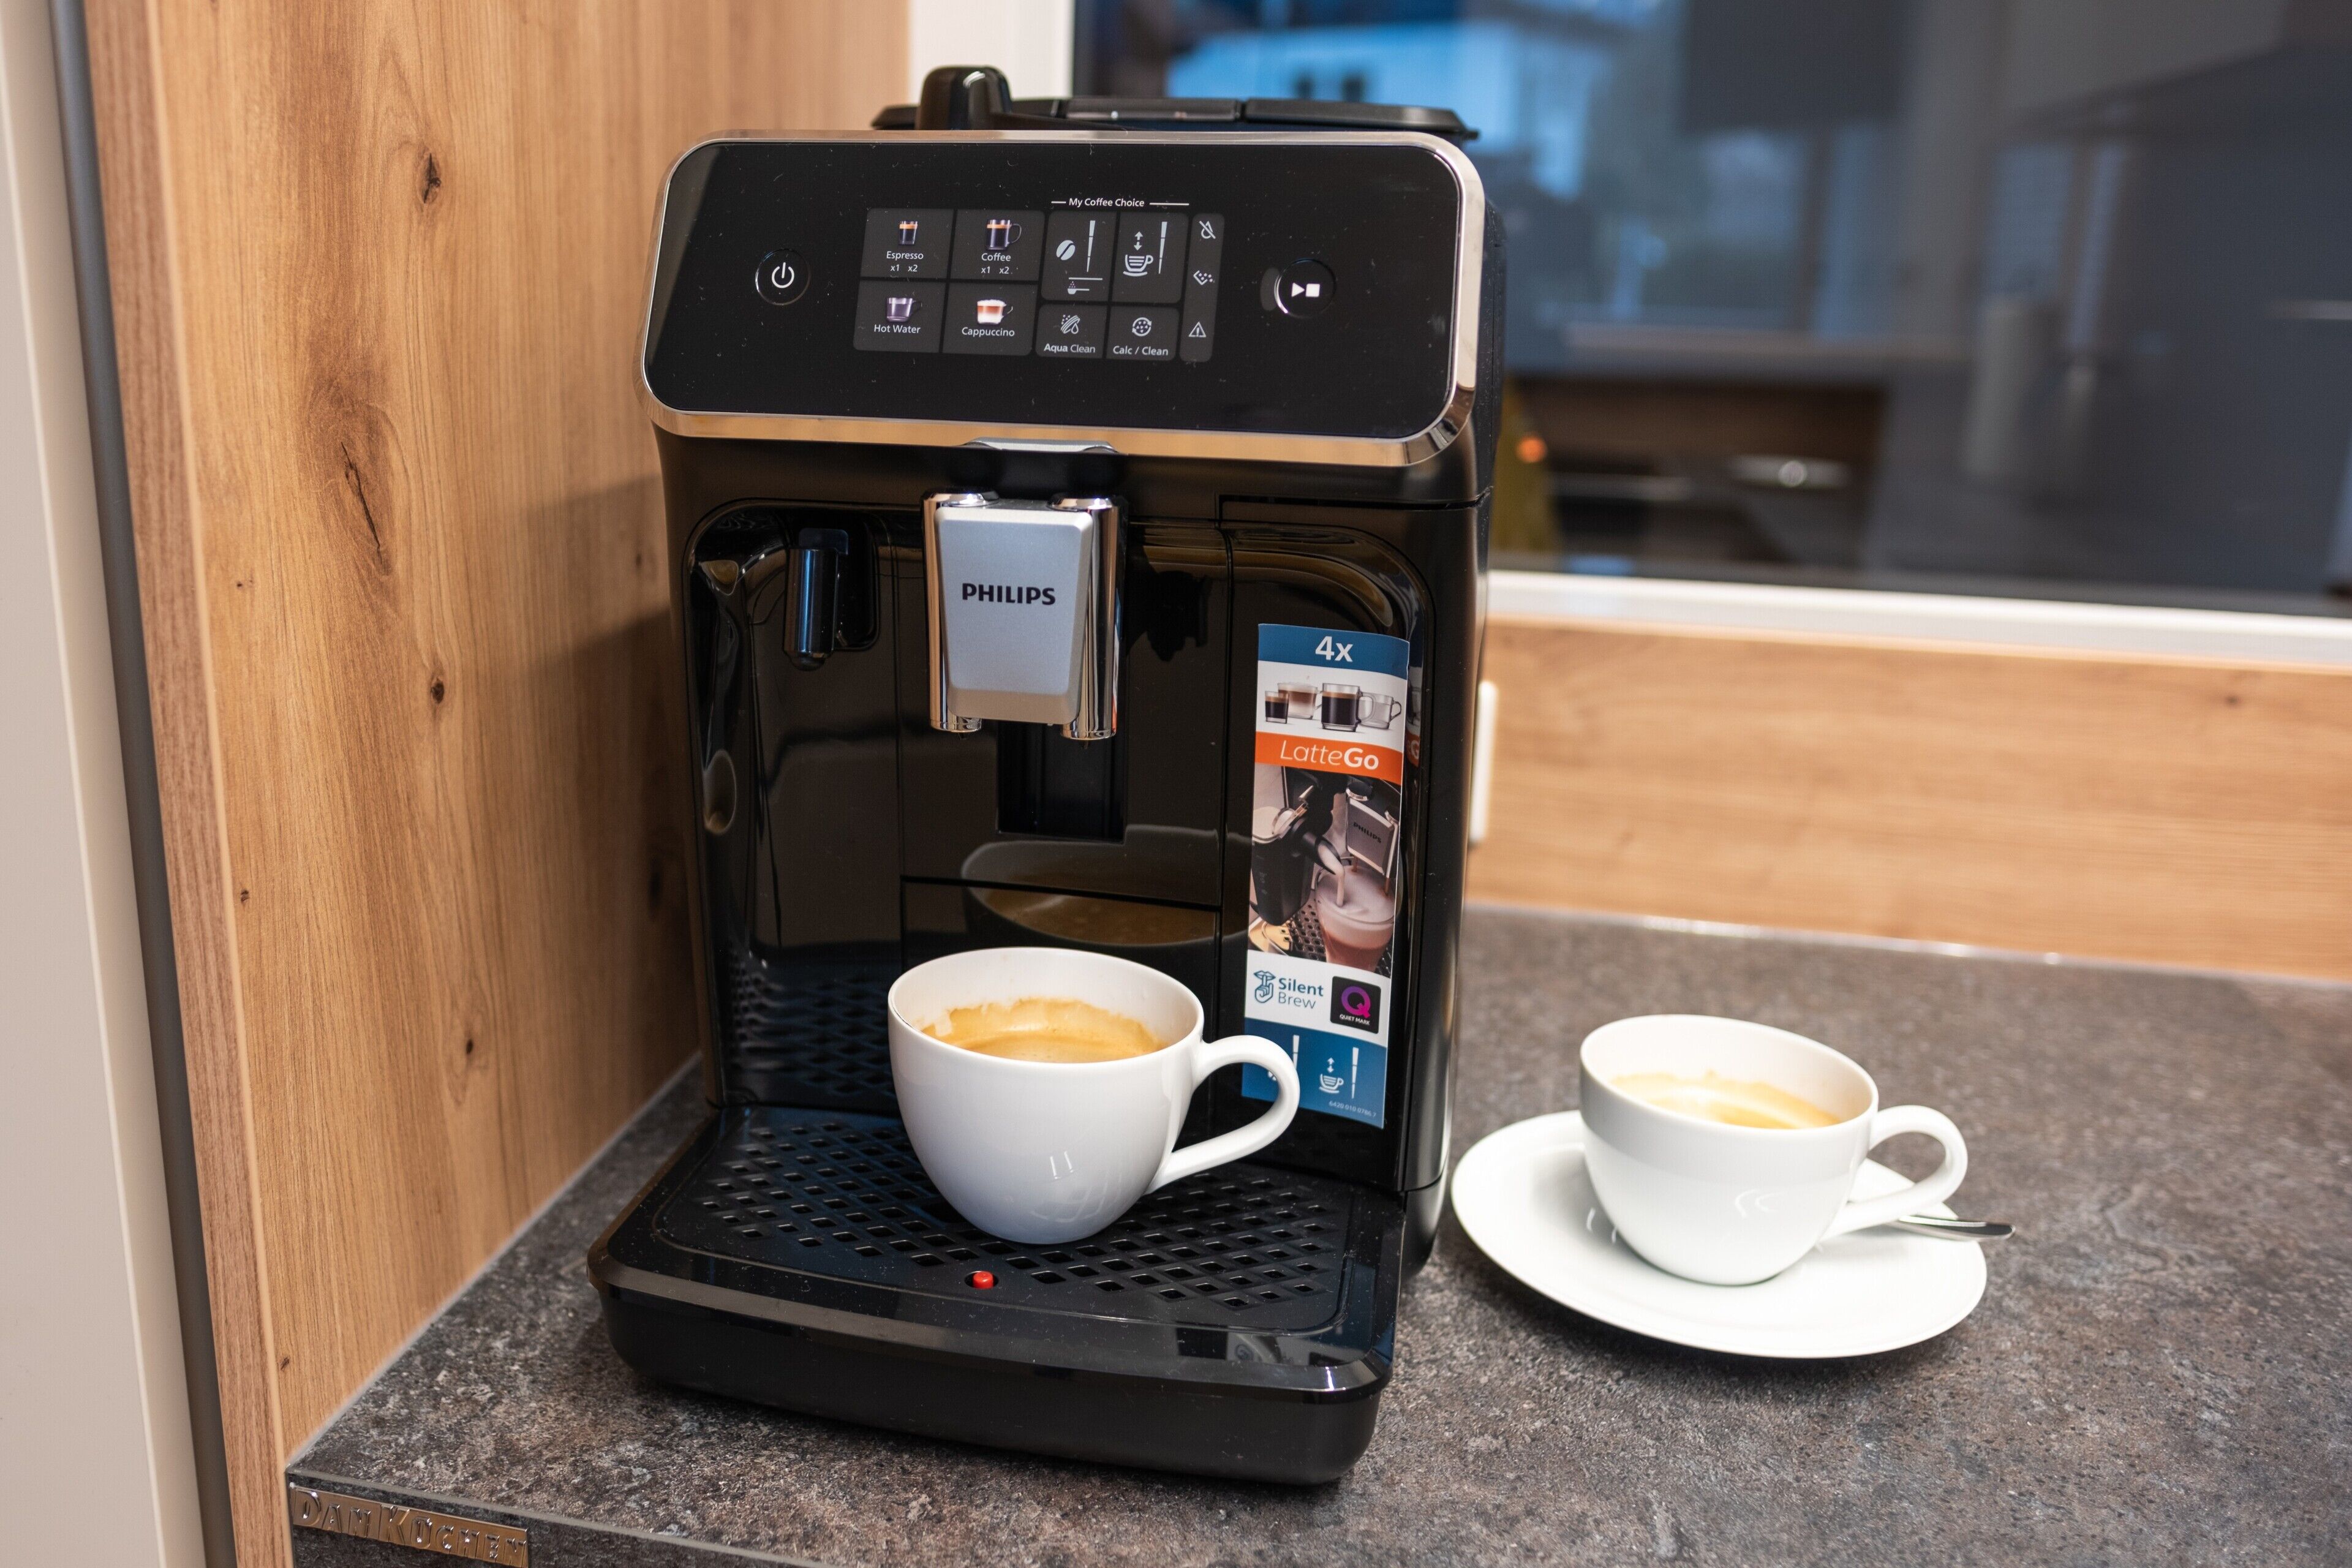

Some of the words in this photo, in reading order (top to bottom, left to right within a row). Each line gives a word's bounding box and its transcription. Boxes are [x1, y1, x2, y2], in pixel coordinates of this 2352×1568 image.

[1069, 198, 1082, 208] My
[1085, 198, 1113, 206] Coffee
[1115, 198, 1145, 207] Choice
[886, 251, 924, 261] Espresso
[981, 253, 1011, 262] Coffee
[893, 325, 921, 333] Water
[962, 327, 1015, 337] Cappuccino
[1044, 343, 1068, 353] Aqua
[1070, 344, 1096, 353] Clean
[1113, 345, 1133, 355] Calc
[1142, 347, 1169, 356] Clean
[962, 583, 1056, 606] PHILIPS
[1315, 636, 1353, 662] 4x
[1280, 740, 1379, 770] LatteGo
[1353, 822, 1382, 843] PHILIPS
[1279, 978, 1324, 997] Silent
[1278, 992, 1316, 1009] Brew
